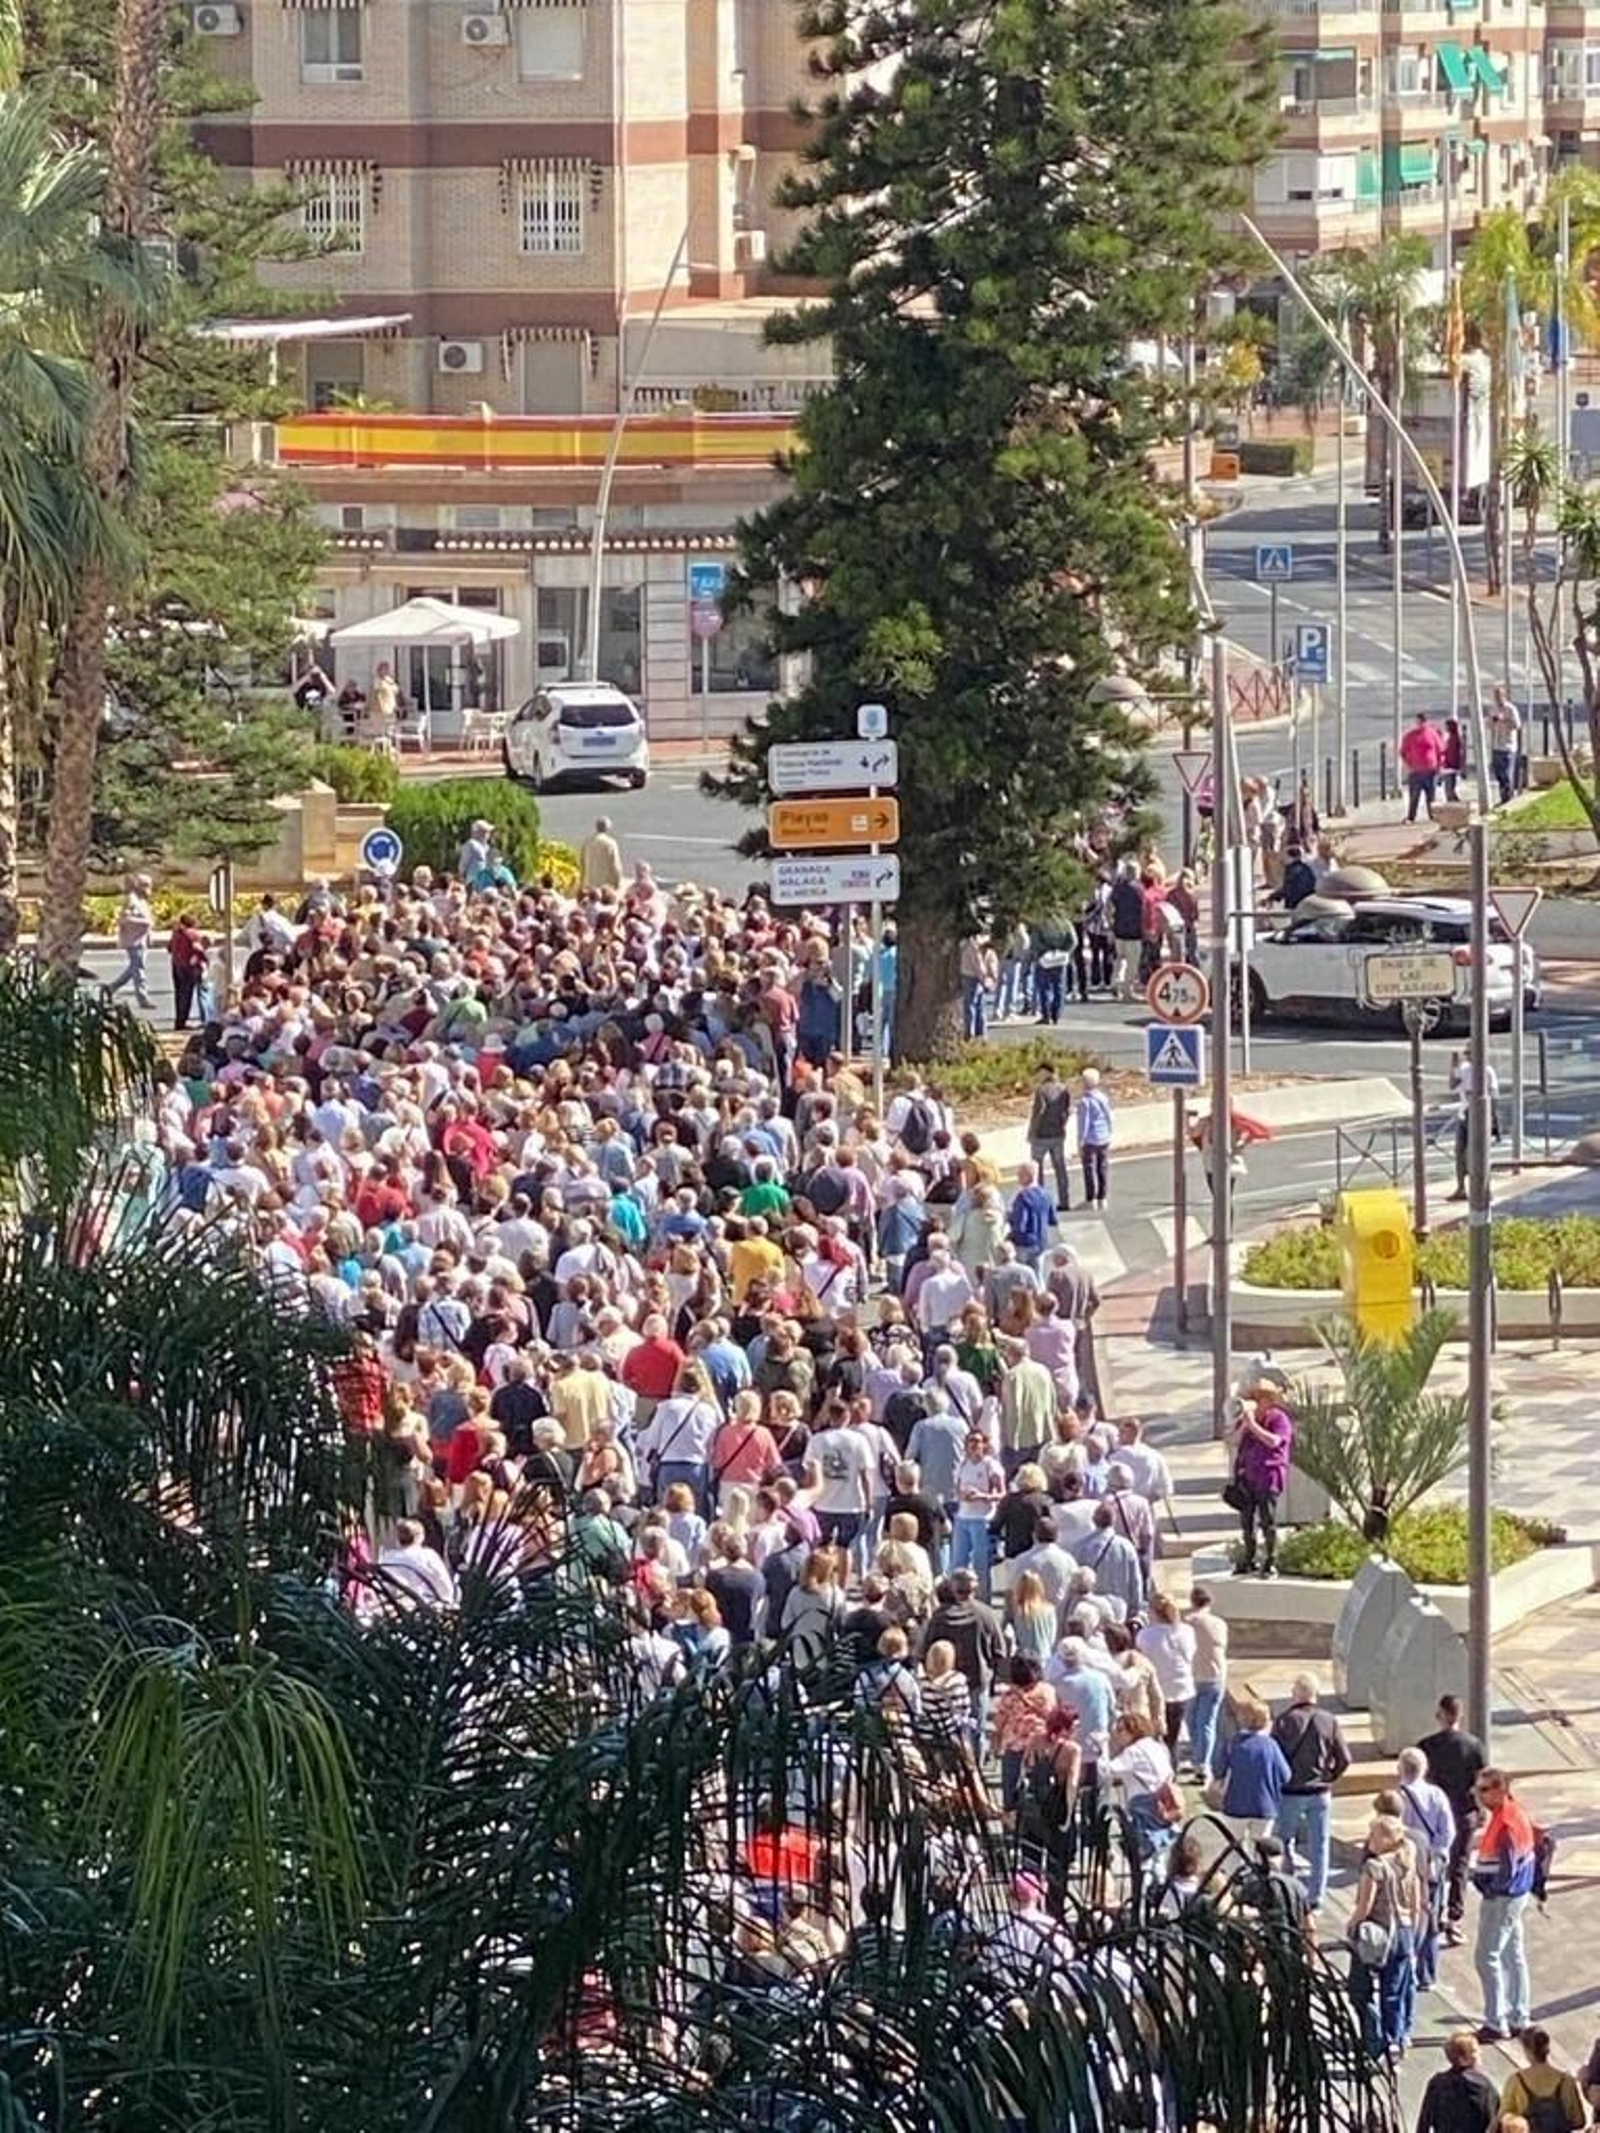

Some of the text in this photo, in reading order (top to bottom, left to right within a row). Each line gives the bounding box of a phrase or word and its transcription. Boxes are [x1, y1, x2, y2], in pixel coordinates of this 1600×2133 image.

[1301, 628, 1321, 659] P
[781, 811, 829, 827] Playas
[778, 865, 831, 875] GRANADA
